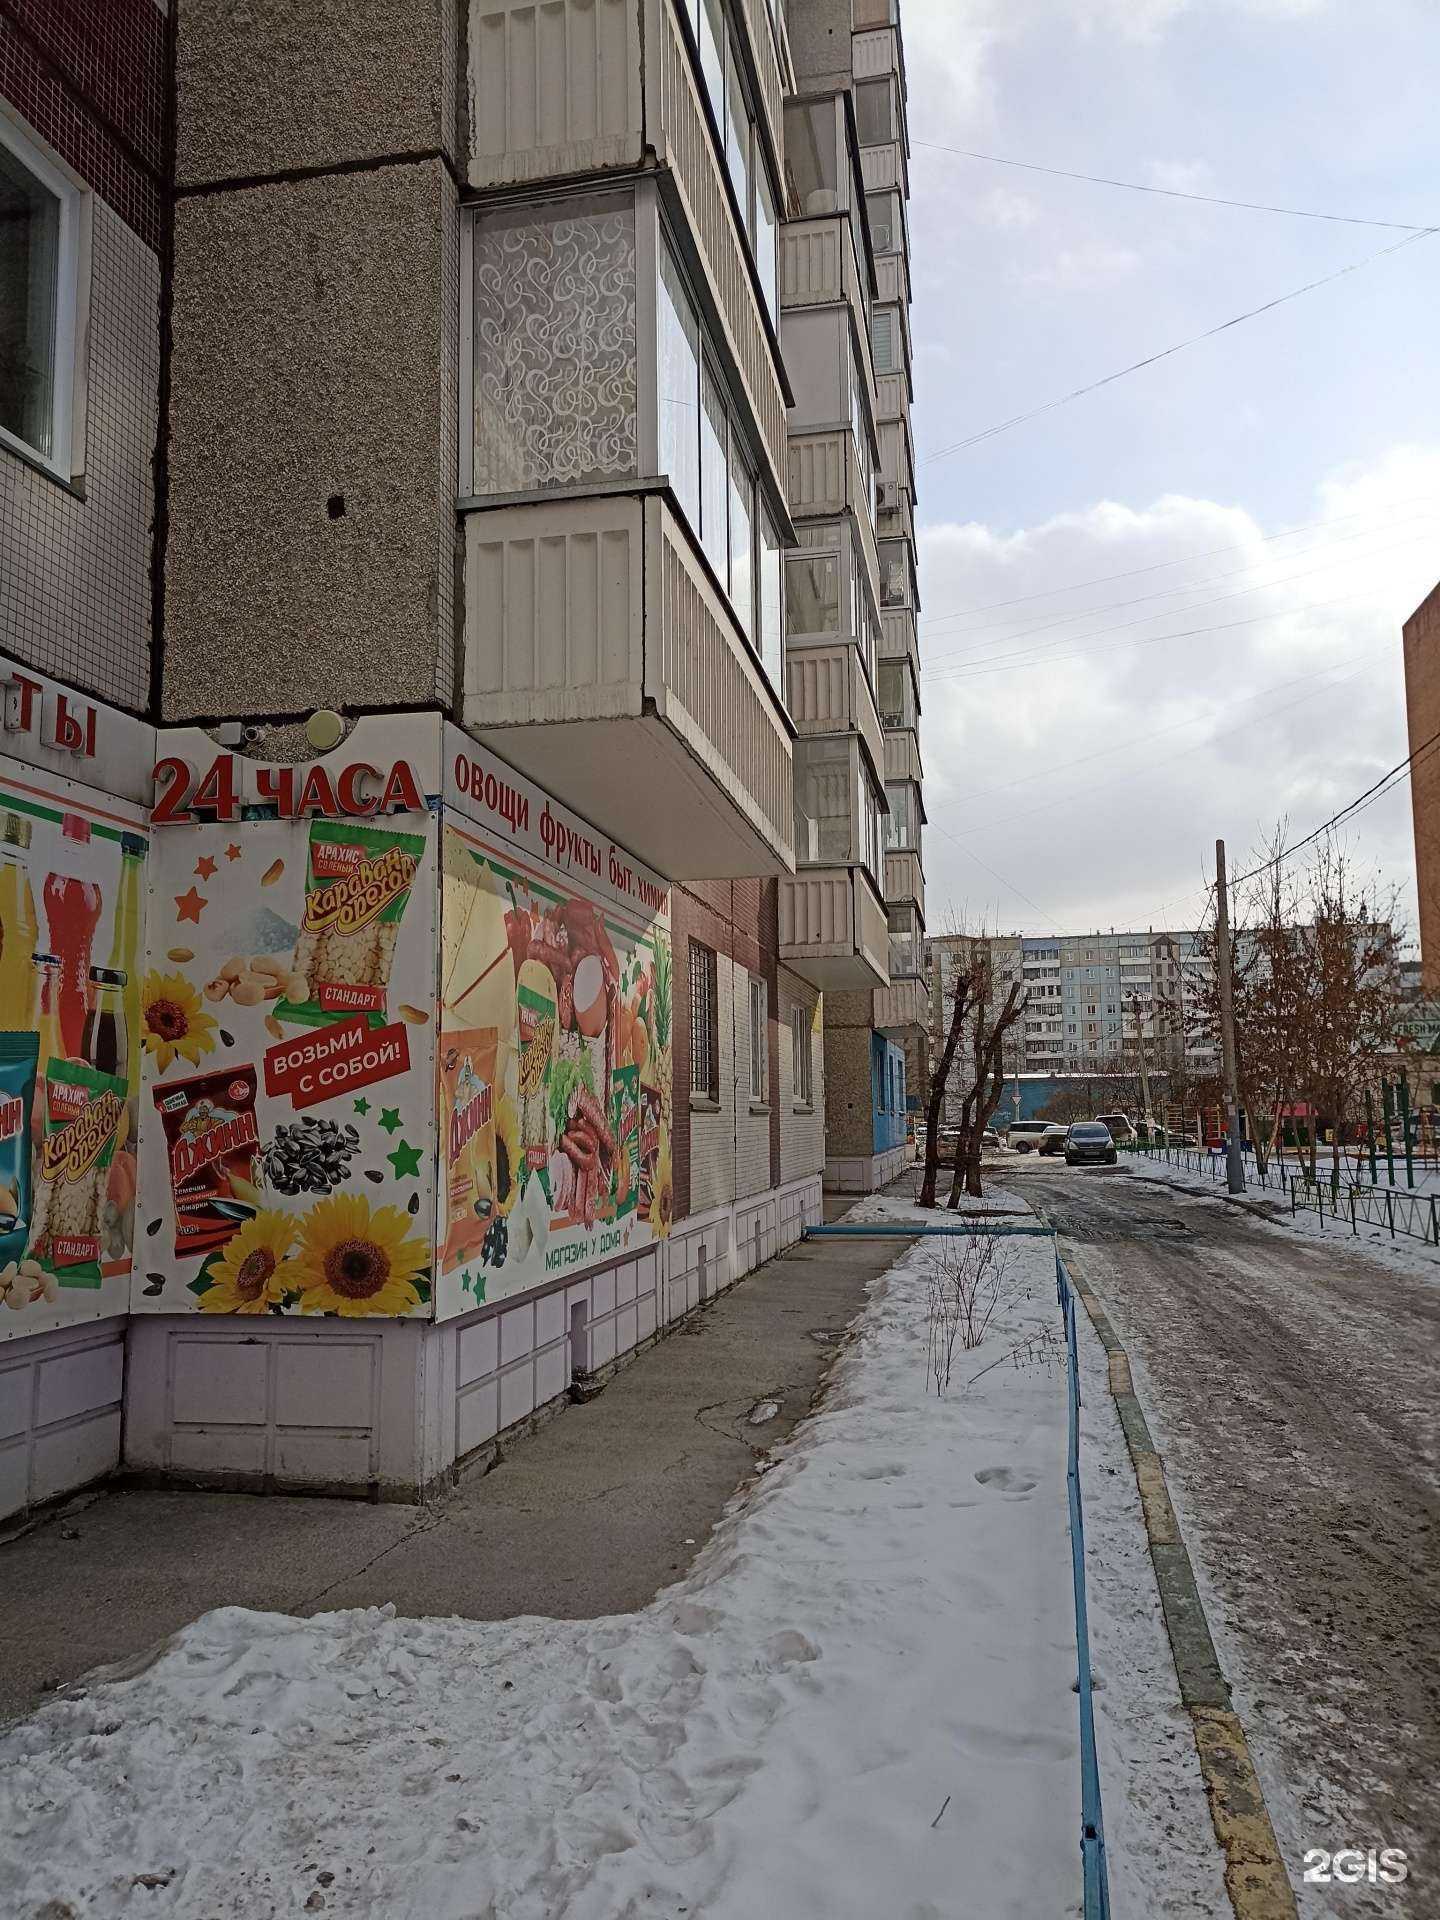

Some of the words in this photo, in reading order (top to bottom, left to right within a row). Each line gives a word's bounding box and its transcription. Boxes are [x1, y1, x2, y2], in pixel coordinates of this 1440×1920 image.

[151, 755, 239, 825] 24
[256, 760, 424, 819] ЧАСА
[317, 845, 360, 863] АРАХИС
[325, 987, 377, 1007] СТАНДАРТ
[273, 1028, 363, 1075] ВОЗЬМИ
[299, 1075, 314, 1092] С
[318, 1042, 401, 1085] СОБОЙ!
[52, 1084, 85, 1105] АРАХИС
[57, 1240, 95, 1257] СТАНДАРТ
[545, 1240, 588, 1271] МАГАЗИН
[600, 1230, 621, 1254] ДОМА
